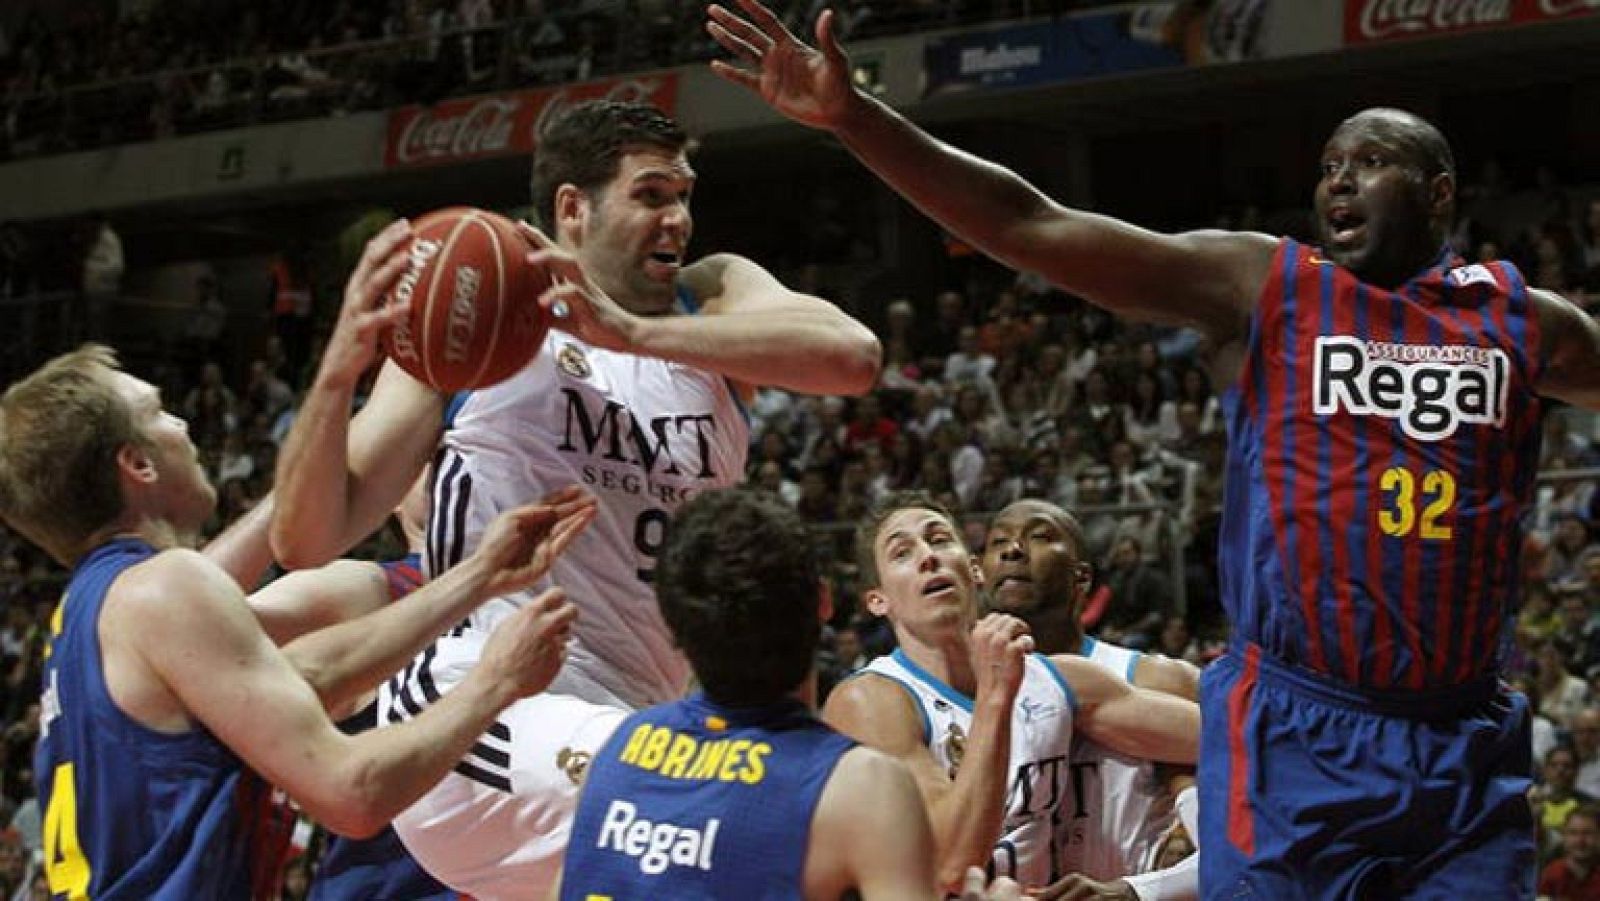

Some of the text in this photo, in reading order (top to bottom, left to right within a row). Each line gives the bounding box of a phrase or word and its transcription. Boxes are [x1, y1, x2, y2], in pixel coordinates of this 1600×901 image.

[1315, 340, 1508, 437] Regal
[1367, 342, 1489, 364] ASSEGURANCES
[556, 387, 717, 479] MMT
[1378, 467, 1455, 538] 32
[634, 508, 668, 582] 9
[619, 723, 773, 784] ABRINES
[44, 761, 91, 901] 4
[597, 800, 720, 874] Regal
